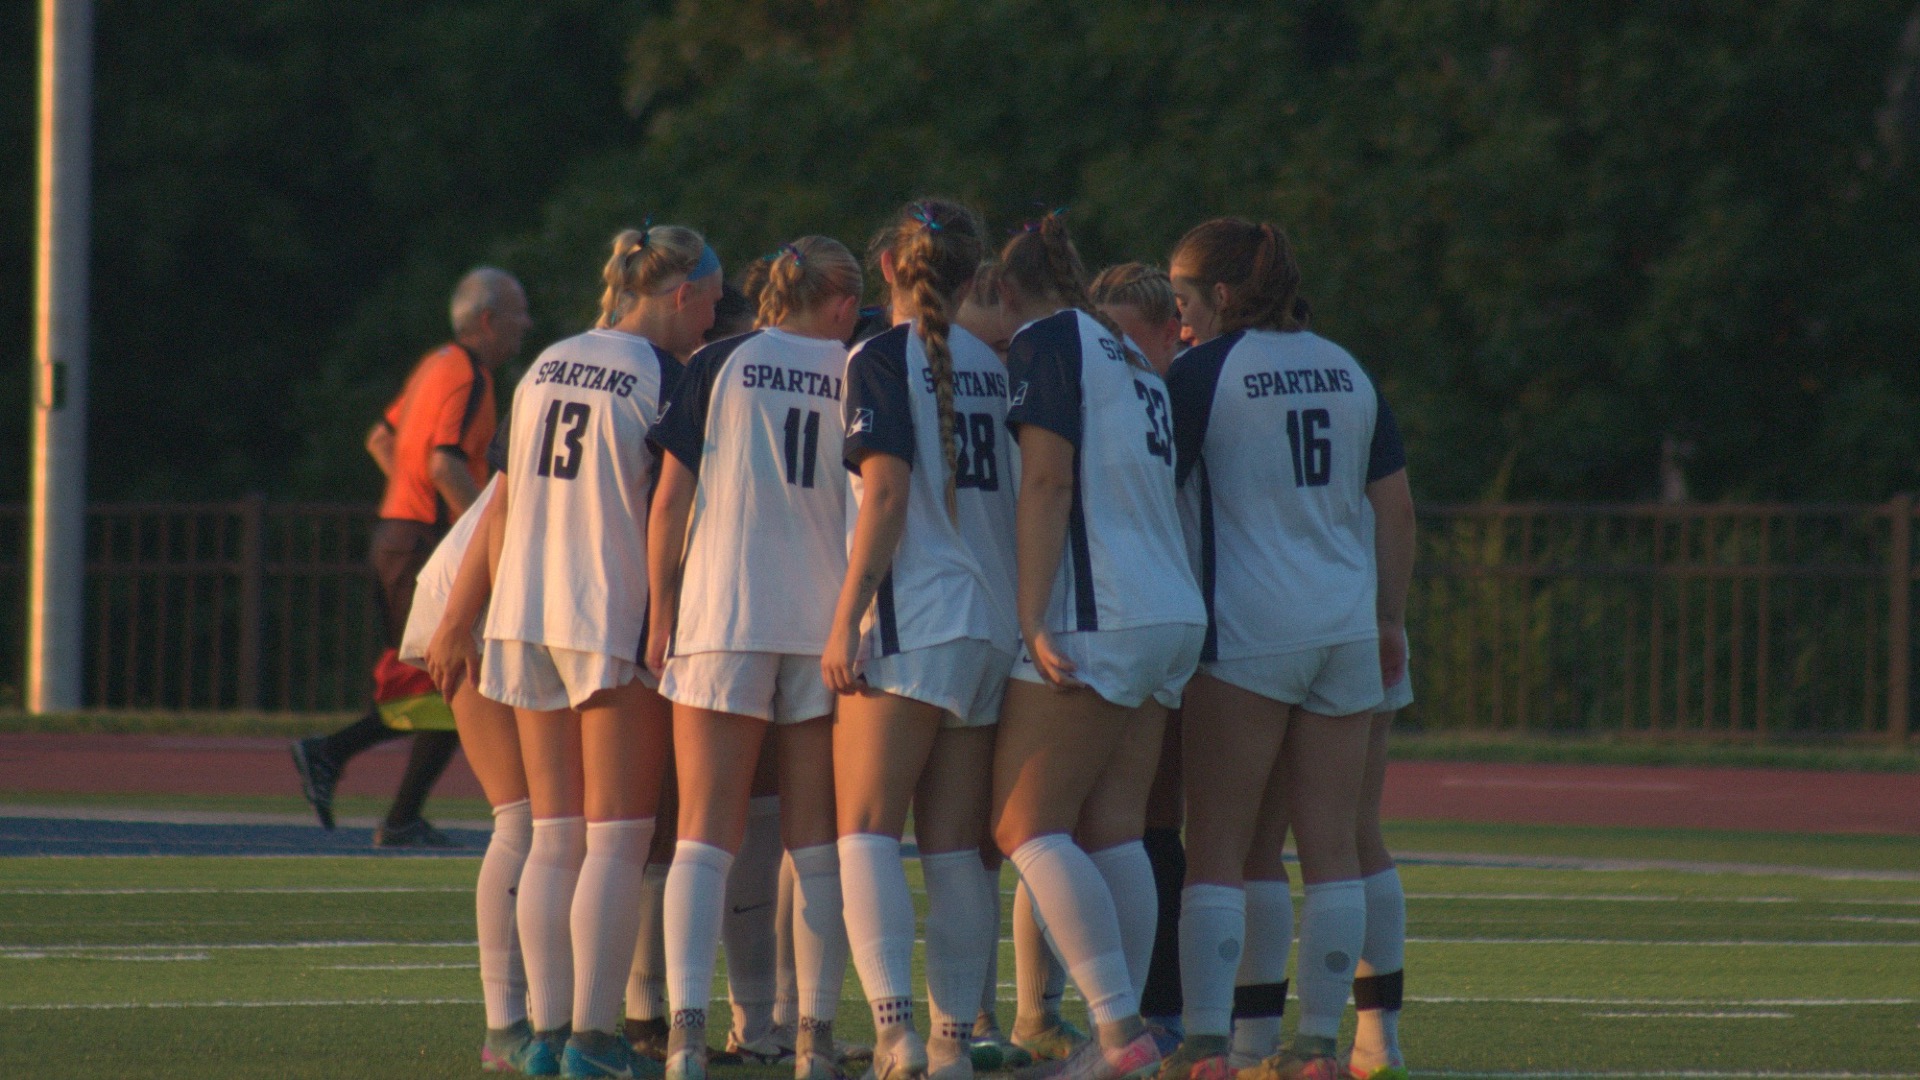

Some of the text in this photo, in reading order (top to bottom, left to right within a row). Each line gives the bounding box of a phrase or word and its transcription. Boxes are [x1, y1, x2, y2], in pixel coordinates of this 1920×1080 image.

[535, 360, 638, 399] SPARTANS
[921, 367, 1008, 398] SRTANS
[1243, 368, 1354, 399] SPARTANS
[537, 399, 591, 480] 13
[783, 407, 820, 489] 11
[1133, 378, 1173, 467] 33
[1286, 408, 1332, 489] 16
